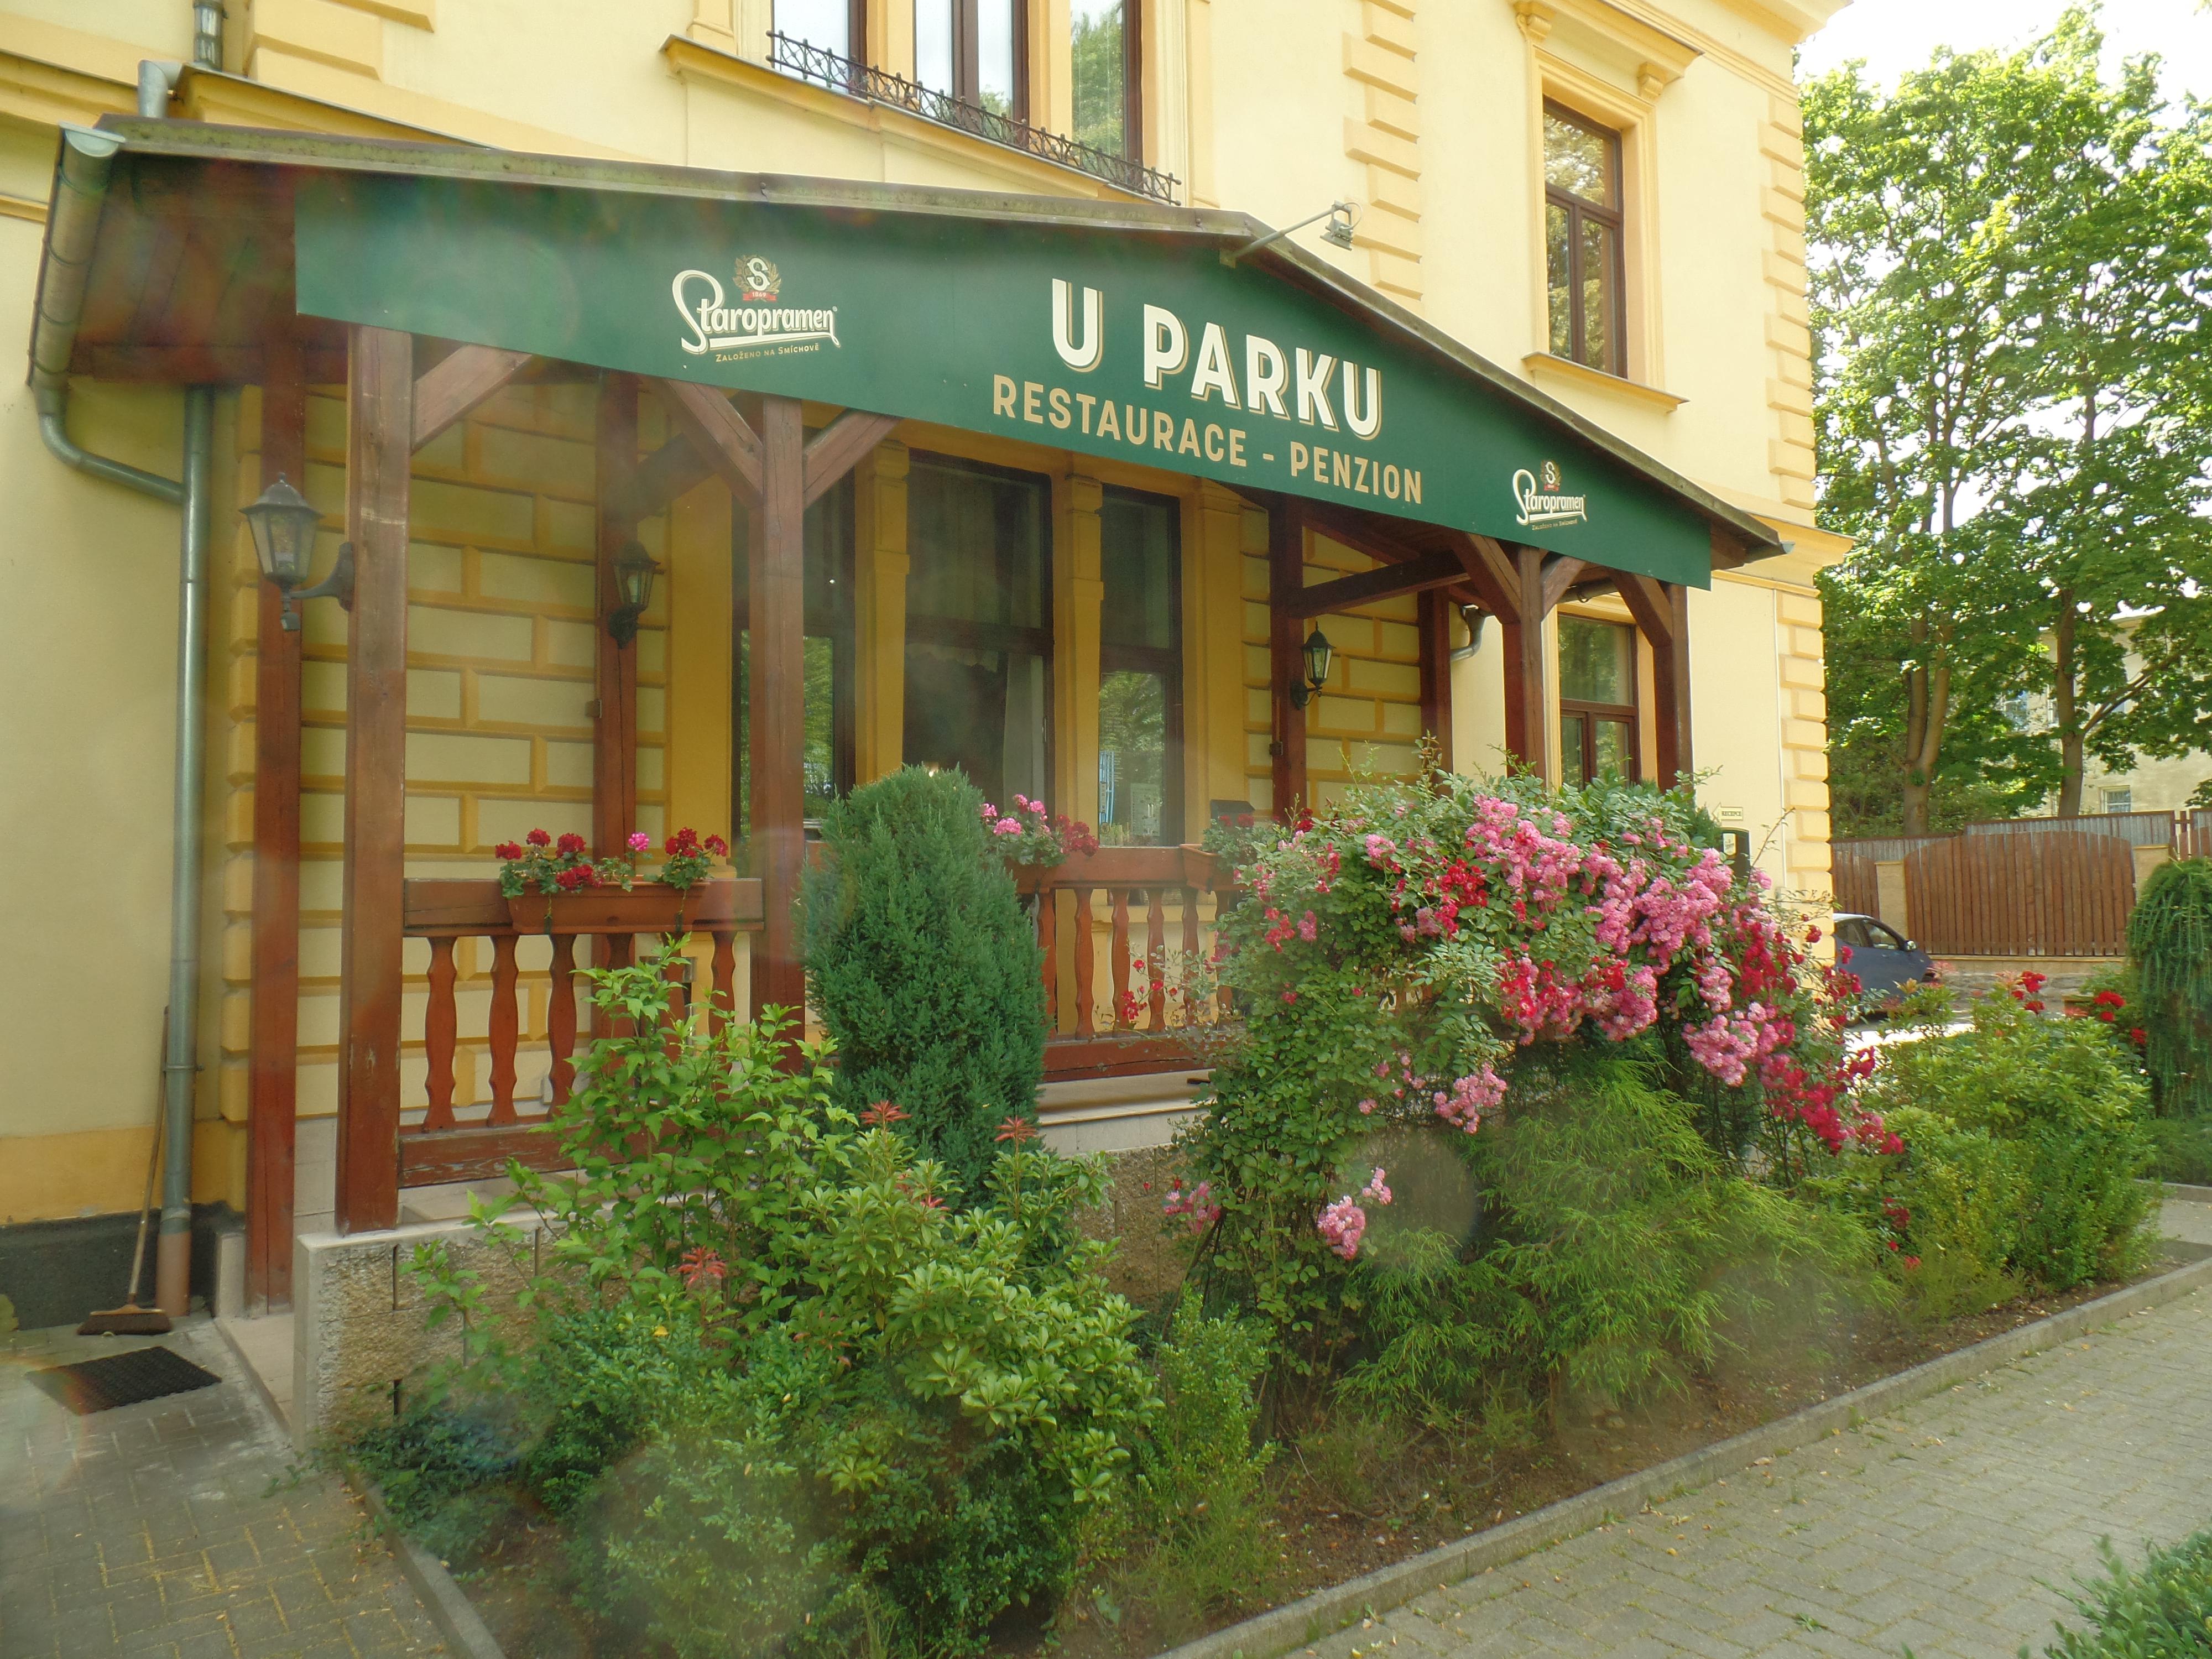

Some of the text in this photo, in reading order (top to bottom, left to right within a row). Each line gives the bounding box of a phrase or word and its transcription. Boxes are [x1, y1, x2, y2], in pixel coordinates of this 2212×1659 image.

[672, 269, 841, 354] Staropramen
[1052, 278, 1382, 441] U PARKU
[993, 374, 1248, 467] RESTAURACE
[1290, 441, 1422, 504] PENZION
[1512, 469, 1588, 525] Staropramen
